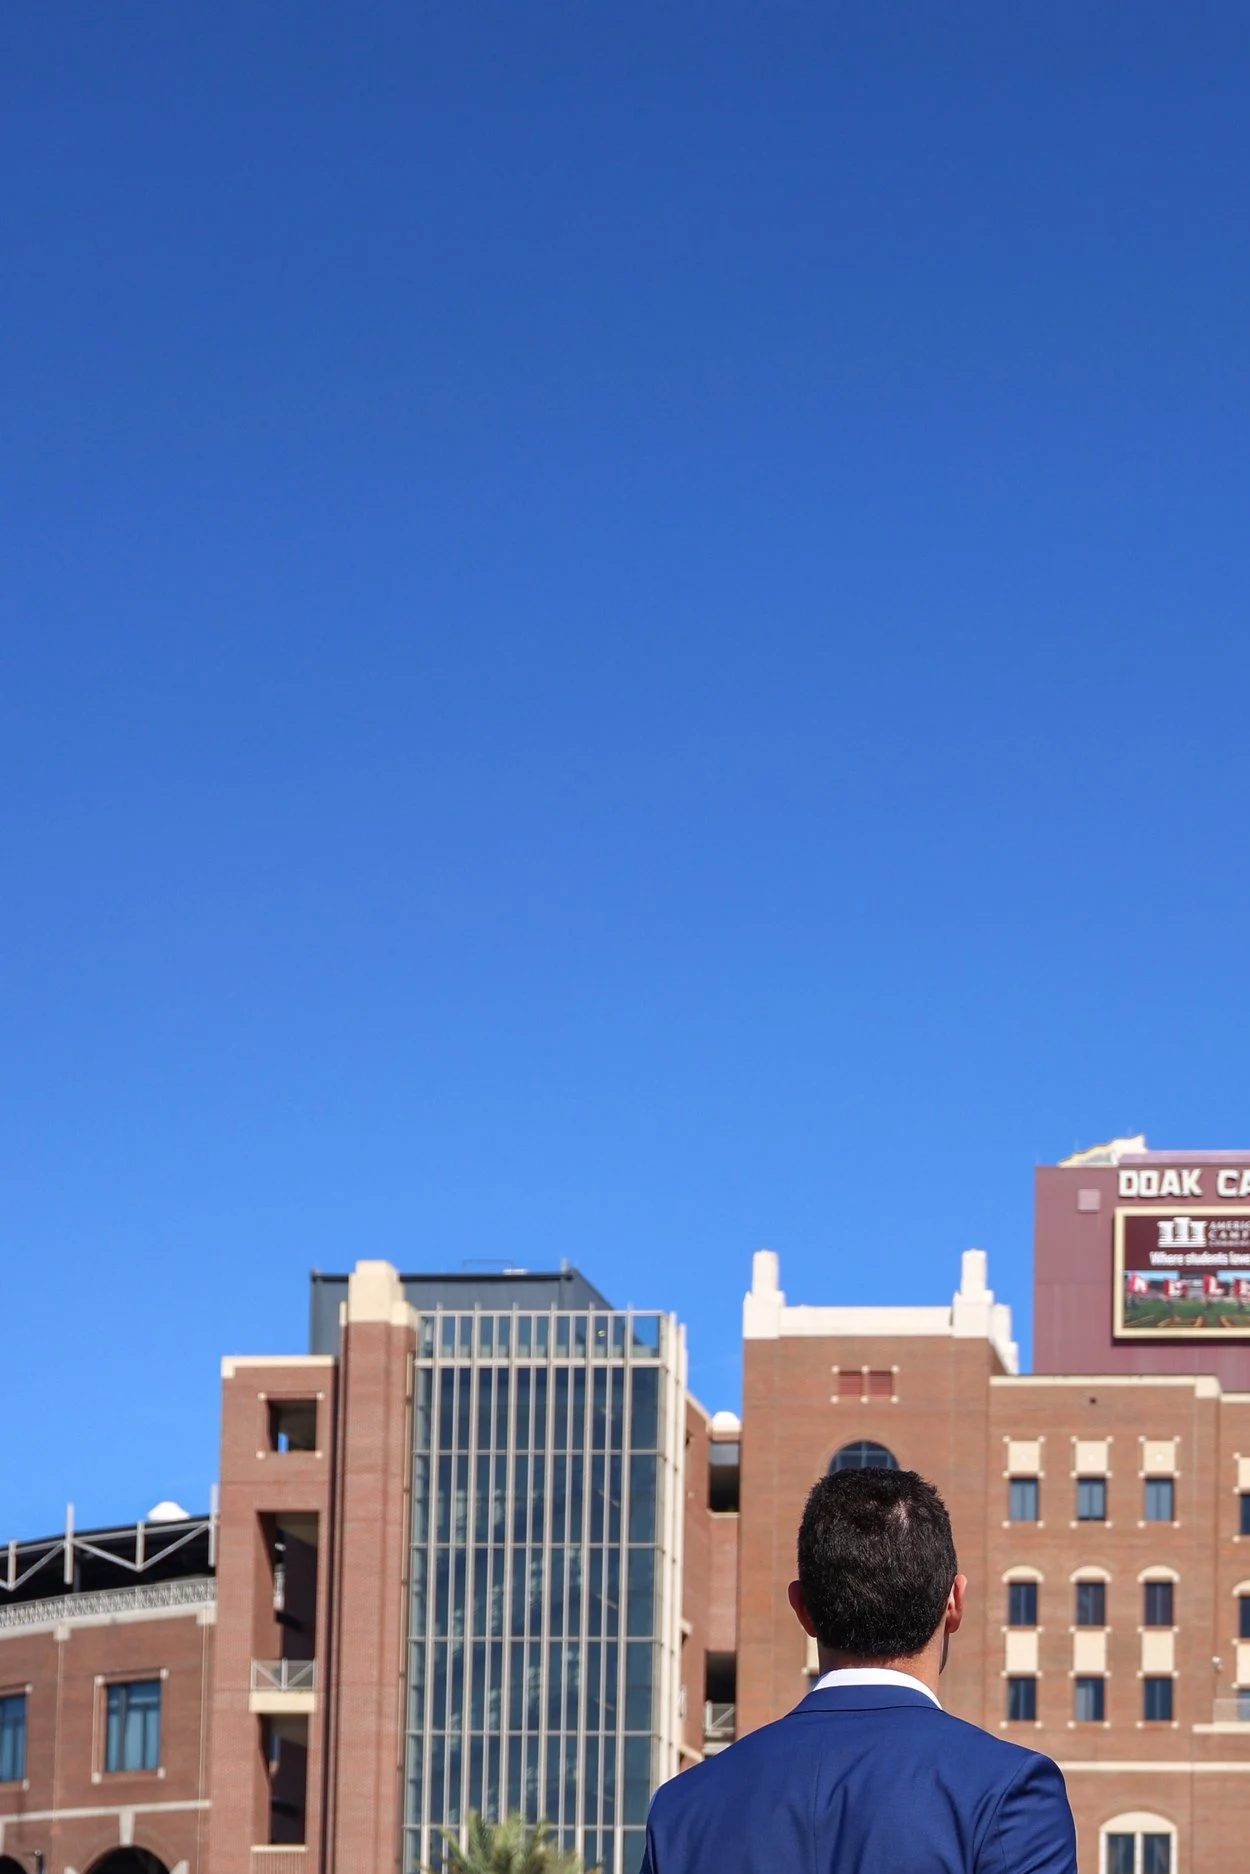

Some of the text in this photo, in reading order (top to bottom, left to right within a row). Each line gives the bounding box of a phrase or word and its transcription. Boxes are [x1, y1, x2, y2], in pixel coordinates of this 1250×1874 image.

[1119, 1168, 1202, 1197] DOAK
[1149, 1251, 1184, 1266] Where
[1185, 1251, 1229, 1266] students
[1229, 1251, 1250, 1266] love
